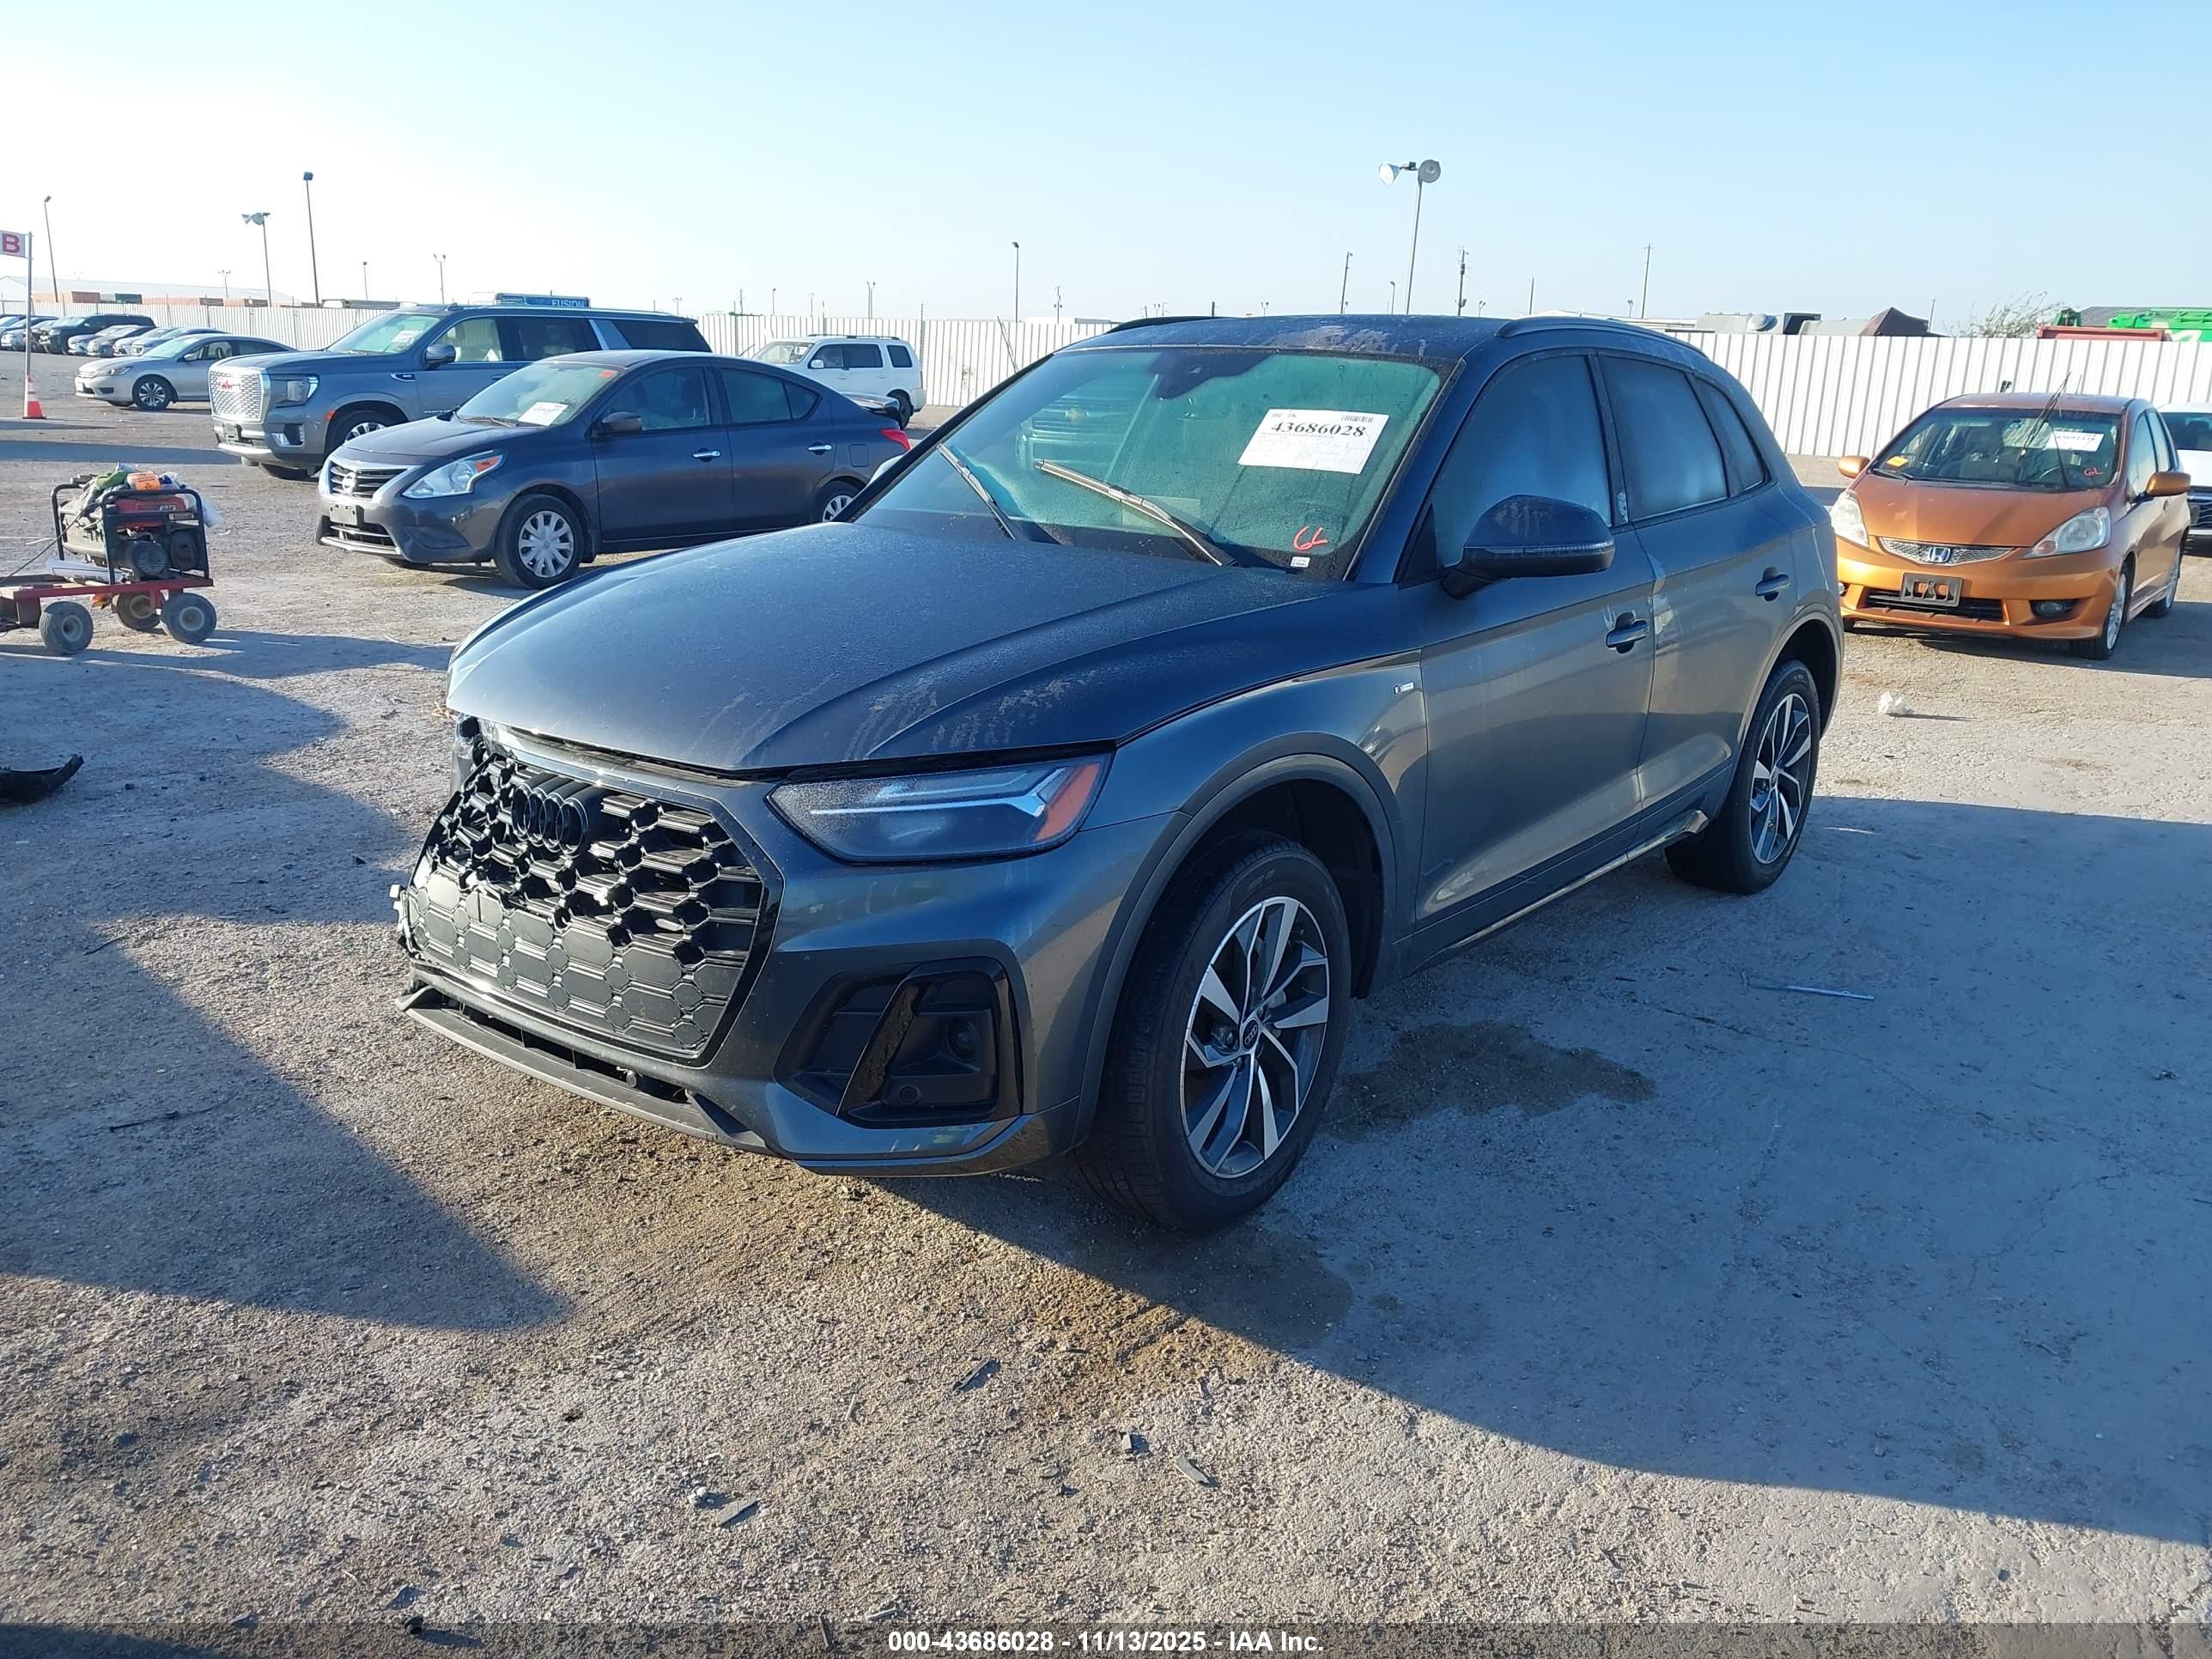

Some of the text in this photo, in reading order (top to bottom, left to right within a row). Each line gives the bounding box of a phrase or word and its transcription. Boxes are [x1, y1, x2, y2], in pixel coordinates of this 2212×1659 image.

[3, 233, 21, 253] B
[551, 299, 585, 308] FUSION
[1271, 422, 1366, 437] 43686028
